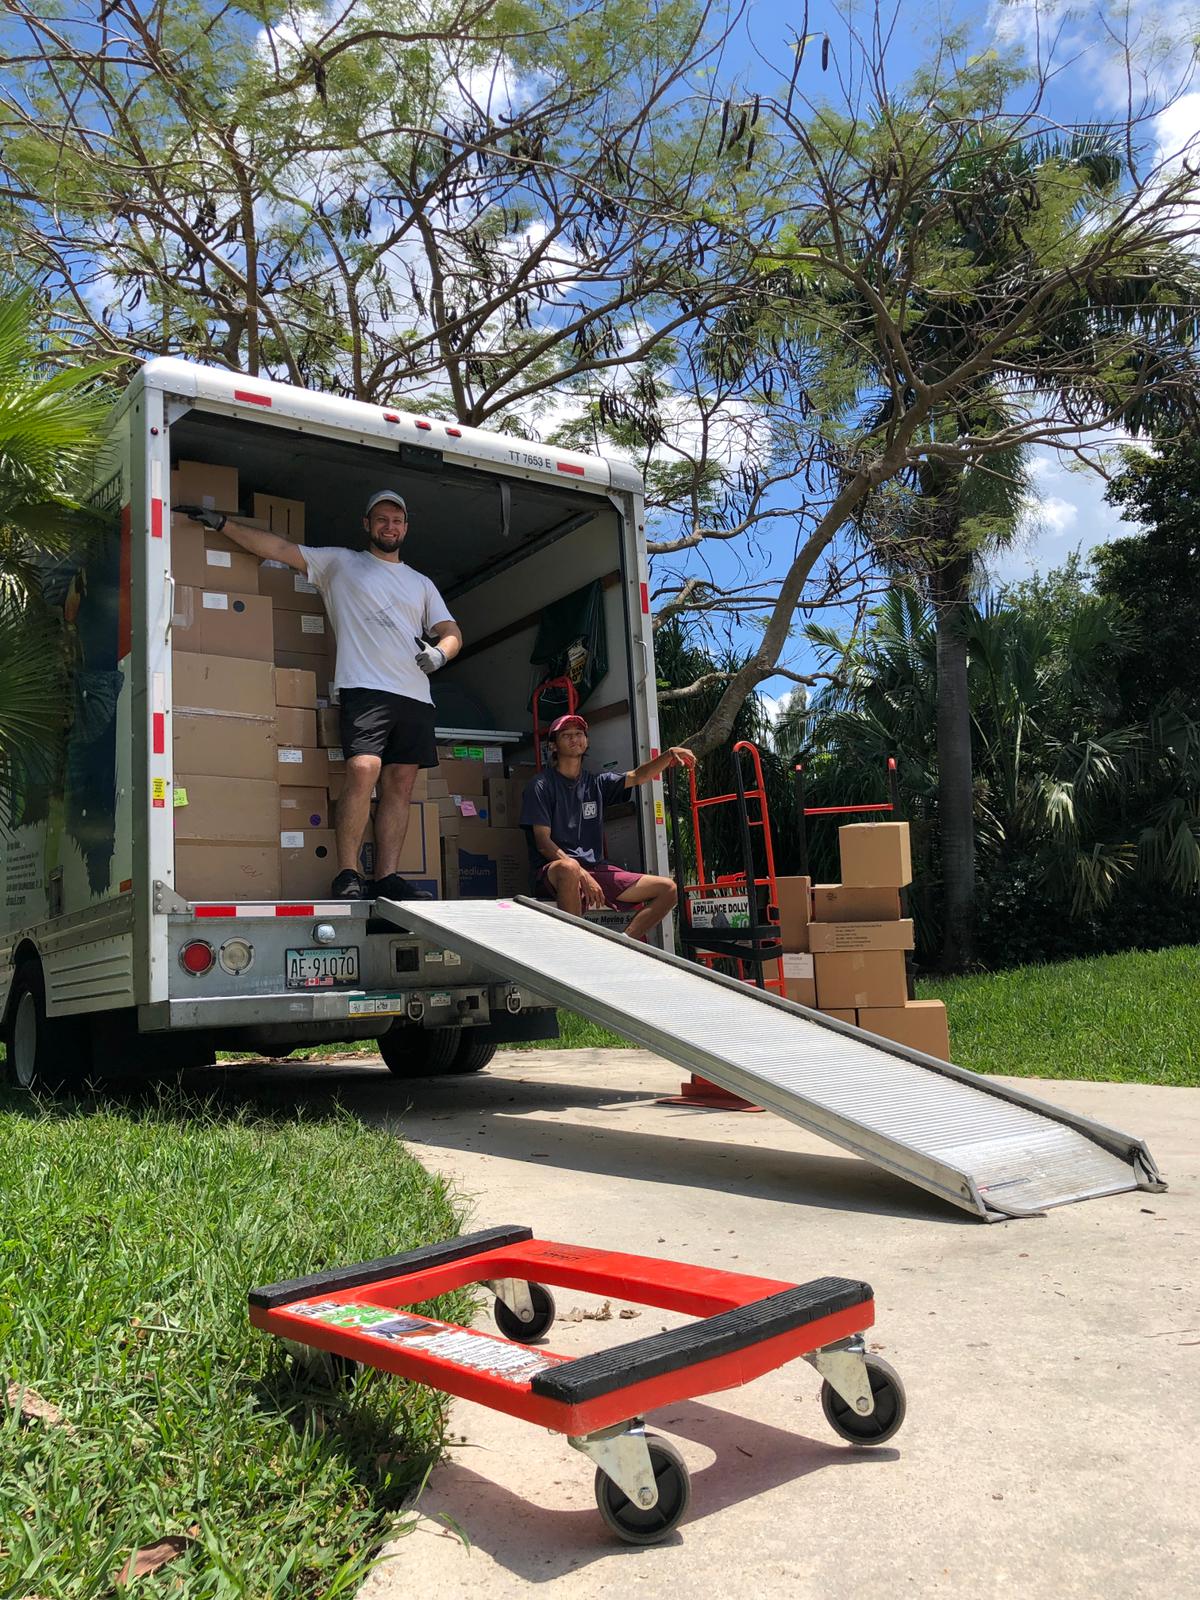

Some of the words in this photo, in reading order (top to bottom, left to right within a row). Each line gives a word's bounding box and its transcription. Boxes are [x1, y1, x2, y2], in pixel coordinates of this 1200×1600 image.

[508, 450, 520, 461] TT
[522, 453, 544, 467] 7653
[545, 458, 552, 468] E
[693, 903, 727, 915] APPLIANCE
[728, 902, 748, 913] DOLLY
[600, 915, 625, 925] Moving
